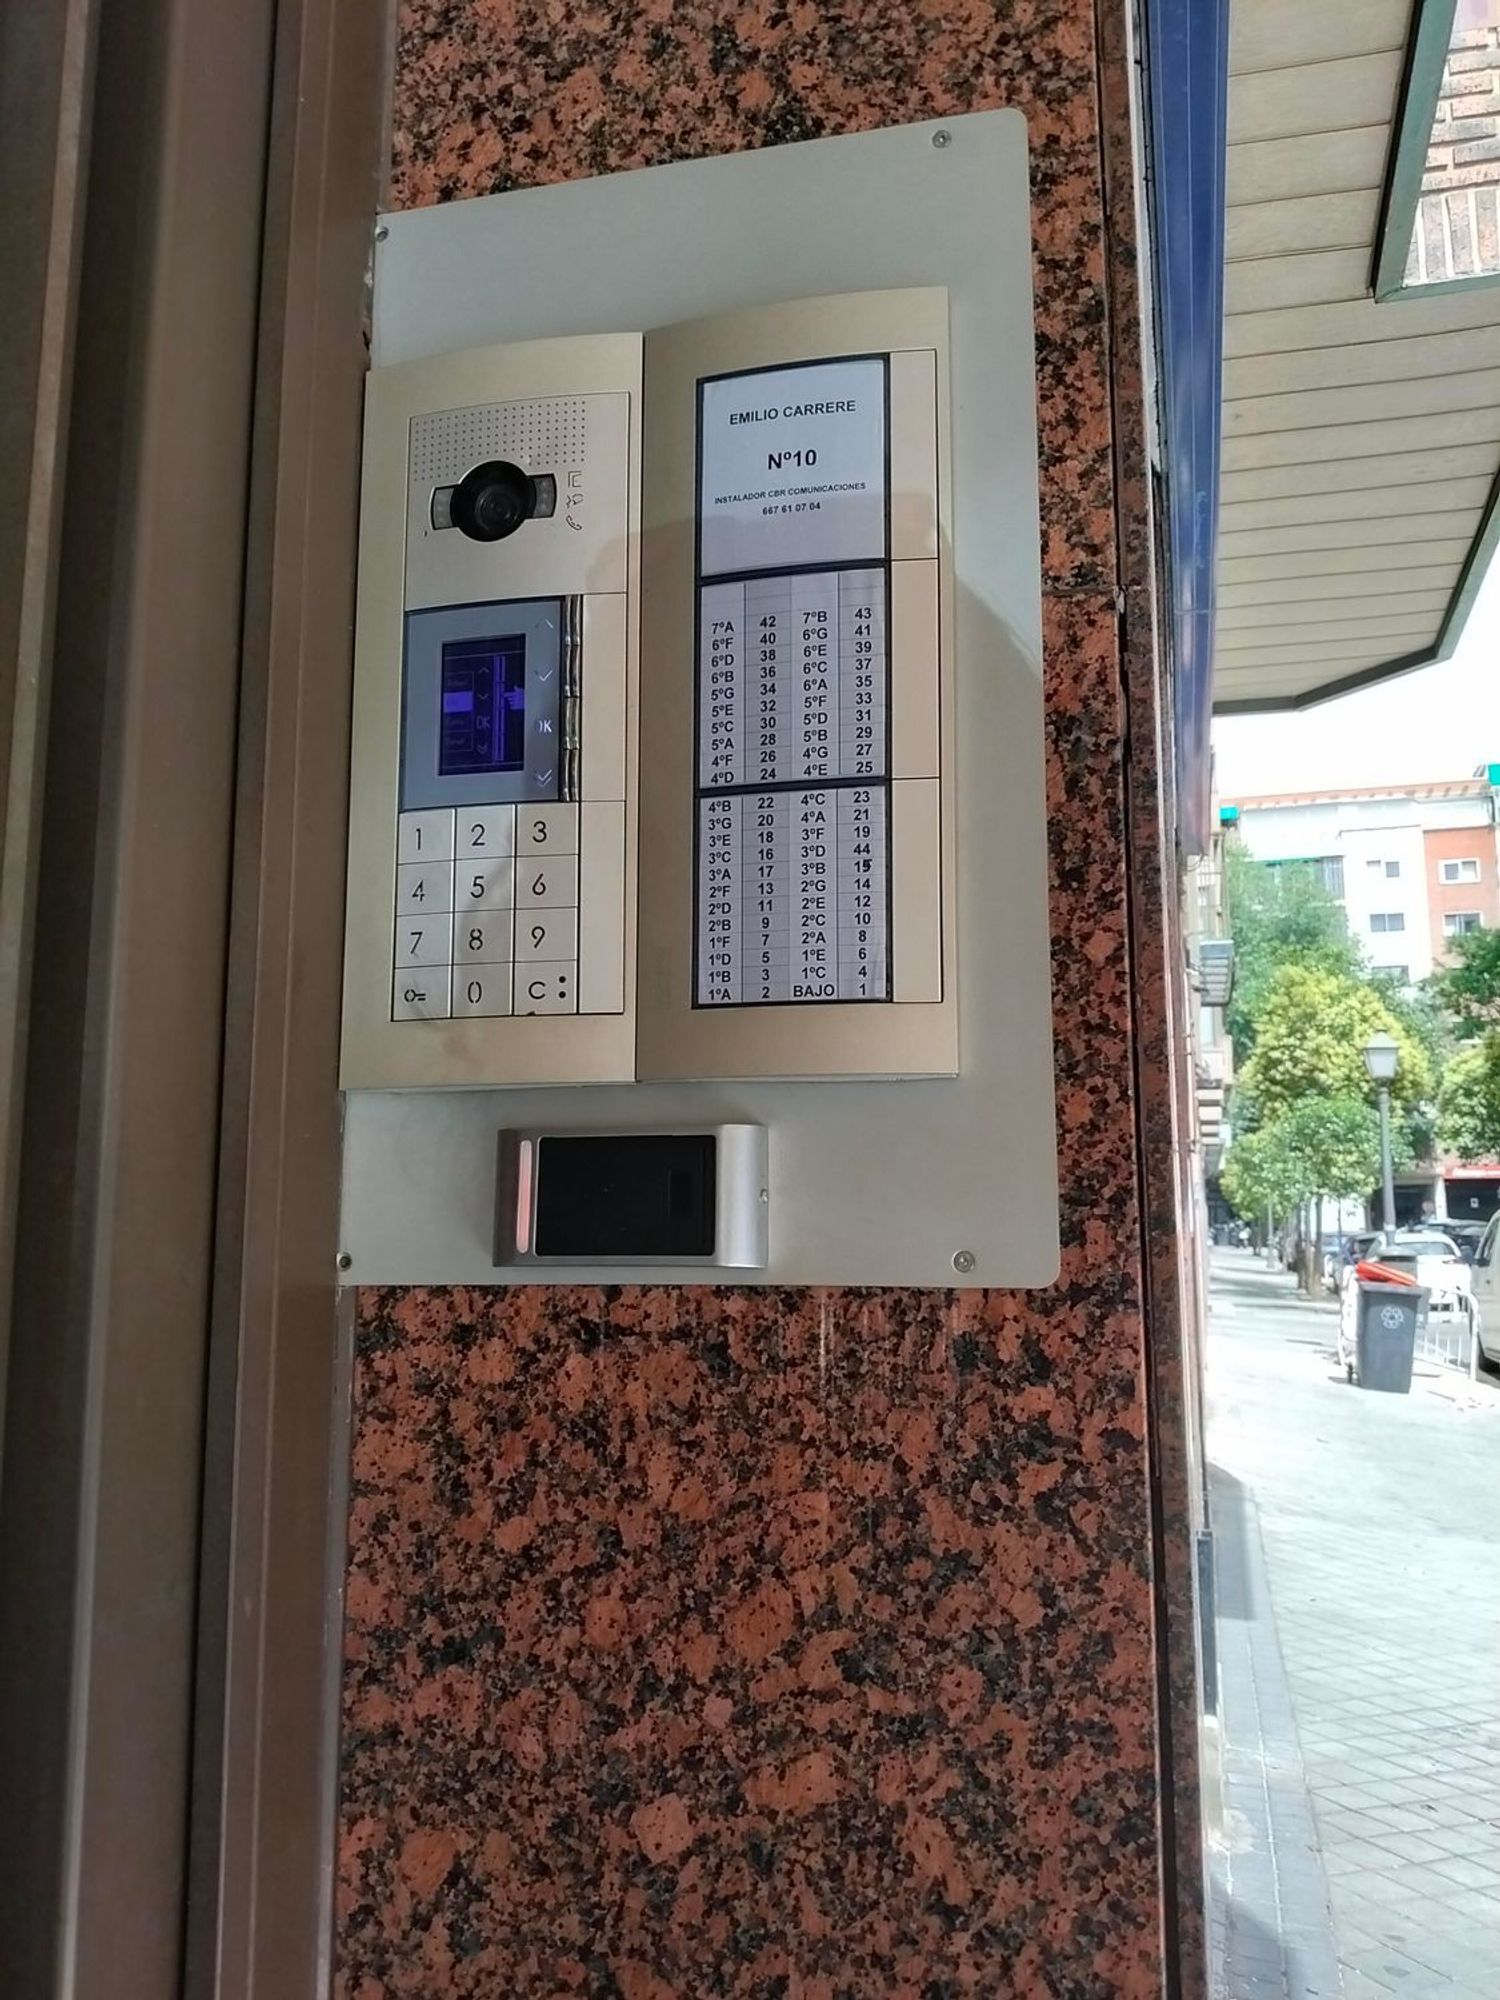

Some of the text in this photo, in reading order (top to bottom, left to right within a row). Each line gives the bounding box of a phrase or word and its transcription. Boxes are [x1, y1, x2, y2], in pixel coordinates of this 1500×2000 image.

[730, 400, 855, 425] EMILIO CARRERE
[768, 450, 816, 470] Nº10
[715, 483, 865, 504] INSTALADOR CBR COMUNICACIONES
[763, 502, 820, 515] 667 61 07 04
[712, 607, 871, 634] 7ºA 42 7ºB 43
[712, 624, 871, 651] 6ºF 40 6ºG 41
[712, 641, 871, 667] 6ºD 38 6ºE 39
[712, 658, 872, 684] 6ºB 36 6ºC 37
[711, 675, 872, 701] 5ºG 34 6ºA 35
[712, 692, 872, 717] 5ºE 32 5ºF 33
[712, 709, 871, 734] 5ºC 30 5ºD 31
[712, 726, 872, 751] 5ºA 28 5ºB 29
[712, 744, 872, 767] 4ºF 26 4ºG 27
[711, 761, 872, 784] 4ºD 24 4ºE 25
[709, 791, 870, 813] 4ºB 22 4ºC 23
[708, 808, 869, 830] 3ºG 20 4ºA 21
[416, 821, 547, 850] 1 2 3
[709, 826, 870, 847] 3ºE 18 3ºF 19
[709, 843, 870, 864] 3ºC 16 3ºD 44
[709, 868, 731, 881] 3ºA
[758, 866, 774, 877] 17
[802, 863, 825, 875] 3ºB
[412, 874, 546, 901] 4 5 6
[710, 878, 870, 898] 2ºF 13 2ºG 14
[709, 895, 870, 915] 2ºD 11 2ºE 12
[709, 913, 870, 932] 2ºB 9 2ºC 10
[411, 926, 545, 954] 7 8 9
[710, 930, 866, 948] 1ºF 7 2ºA 8
[709, 948, 866, 966] 1ºD 5 1ºE 6
[709, 966, 867, 983] 1ºB 3 1ºC 4
[468, 982, 545, 1003] 0 C
[709, 983, 865, 1000] 1ºA 2 BAJO 1
